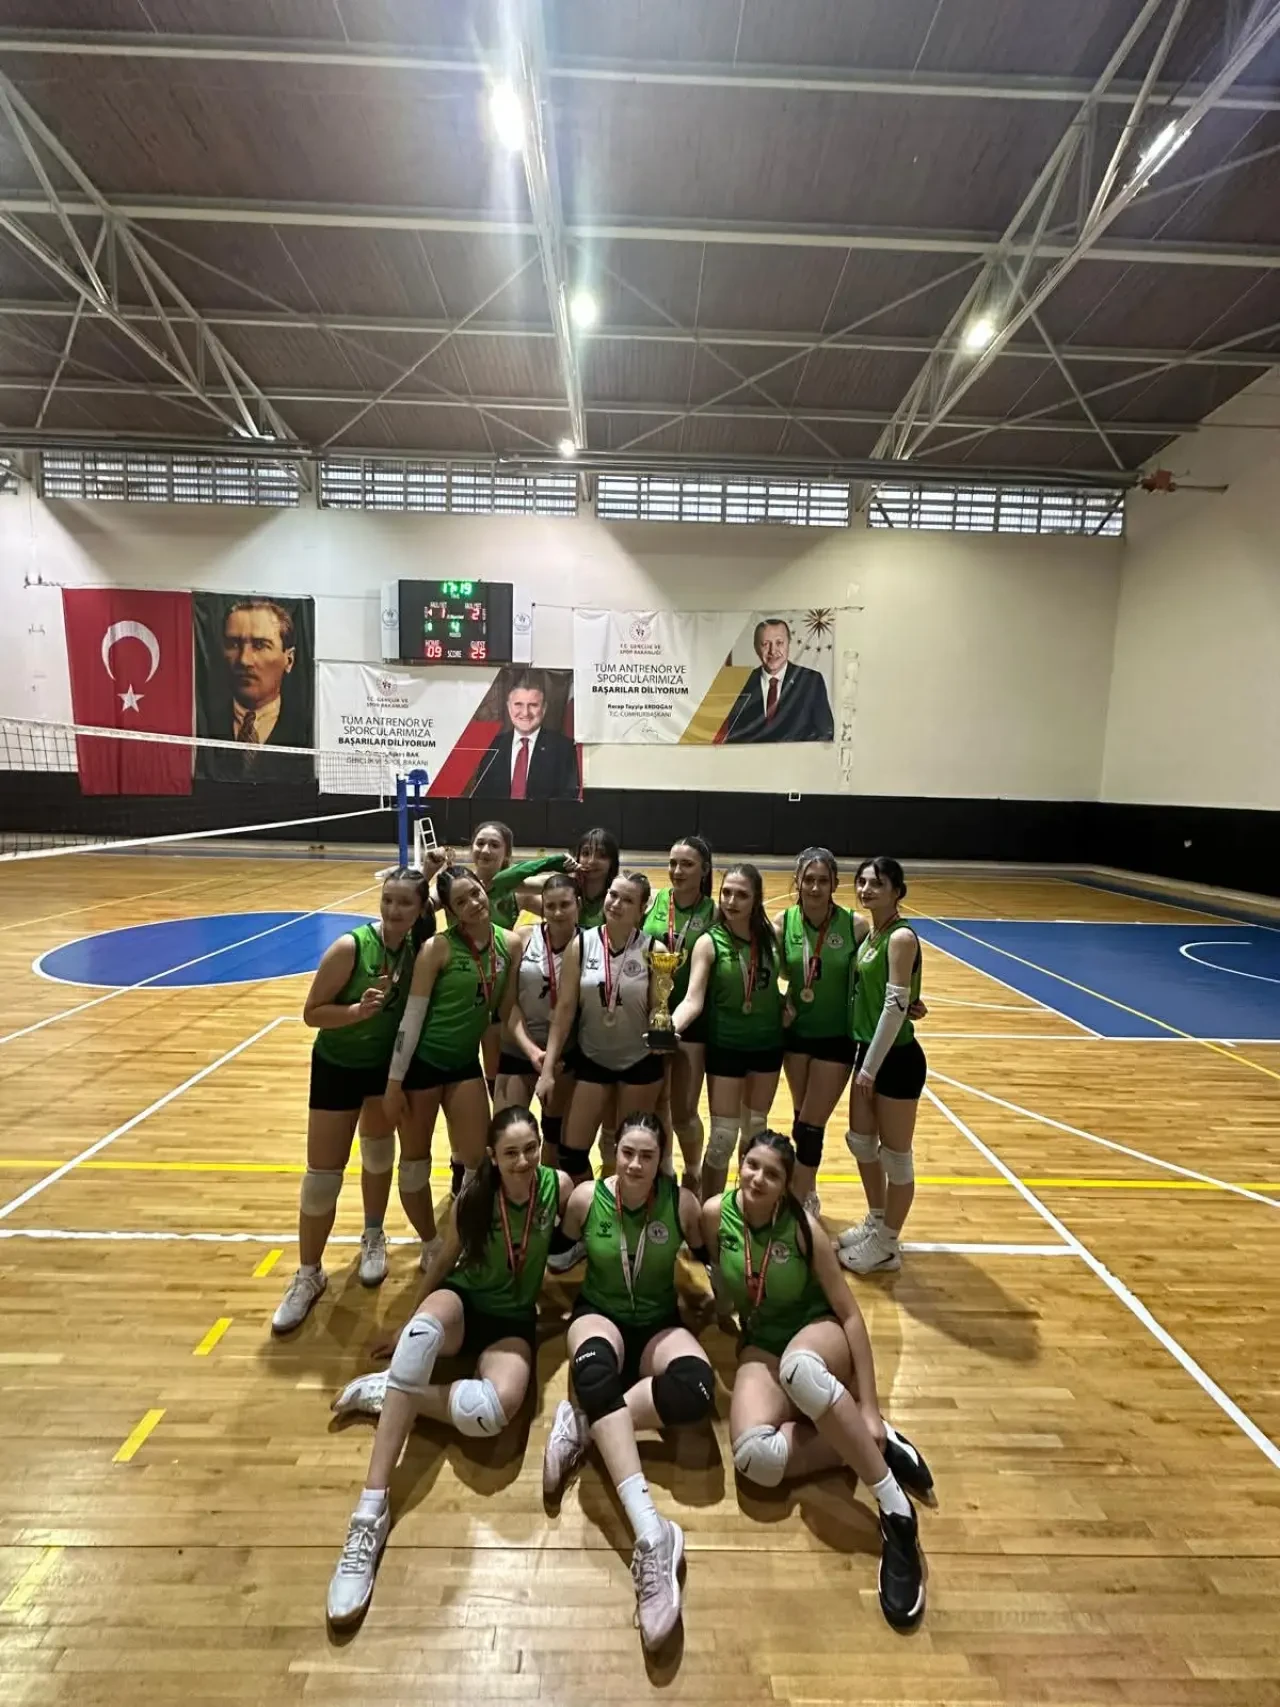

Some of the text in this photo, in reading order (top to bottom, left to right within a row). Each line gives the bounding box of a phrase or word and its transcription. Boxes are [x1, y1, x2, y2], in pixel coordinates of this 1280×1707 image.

[472, 608, 480, 620] 2
[427, 646, 442, 657] 09
[471, 648, 486, 659] 25
[594, 663, 686, 674] TÜM ANTRENÖR VE
[597, 674, 684, 685] SPORCULARIMIZA
[592, 686, 689, 695] BAŞARILAR DİLİYORUM
[341, 715, 433, 728] TÜM ANTRENÖR VE
[344, 726, 431, 737] SPORCULARIMIZA
[338, 737, 436, 747] BAŞARILAR DİLİYORUM
